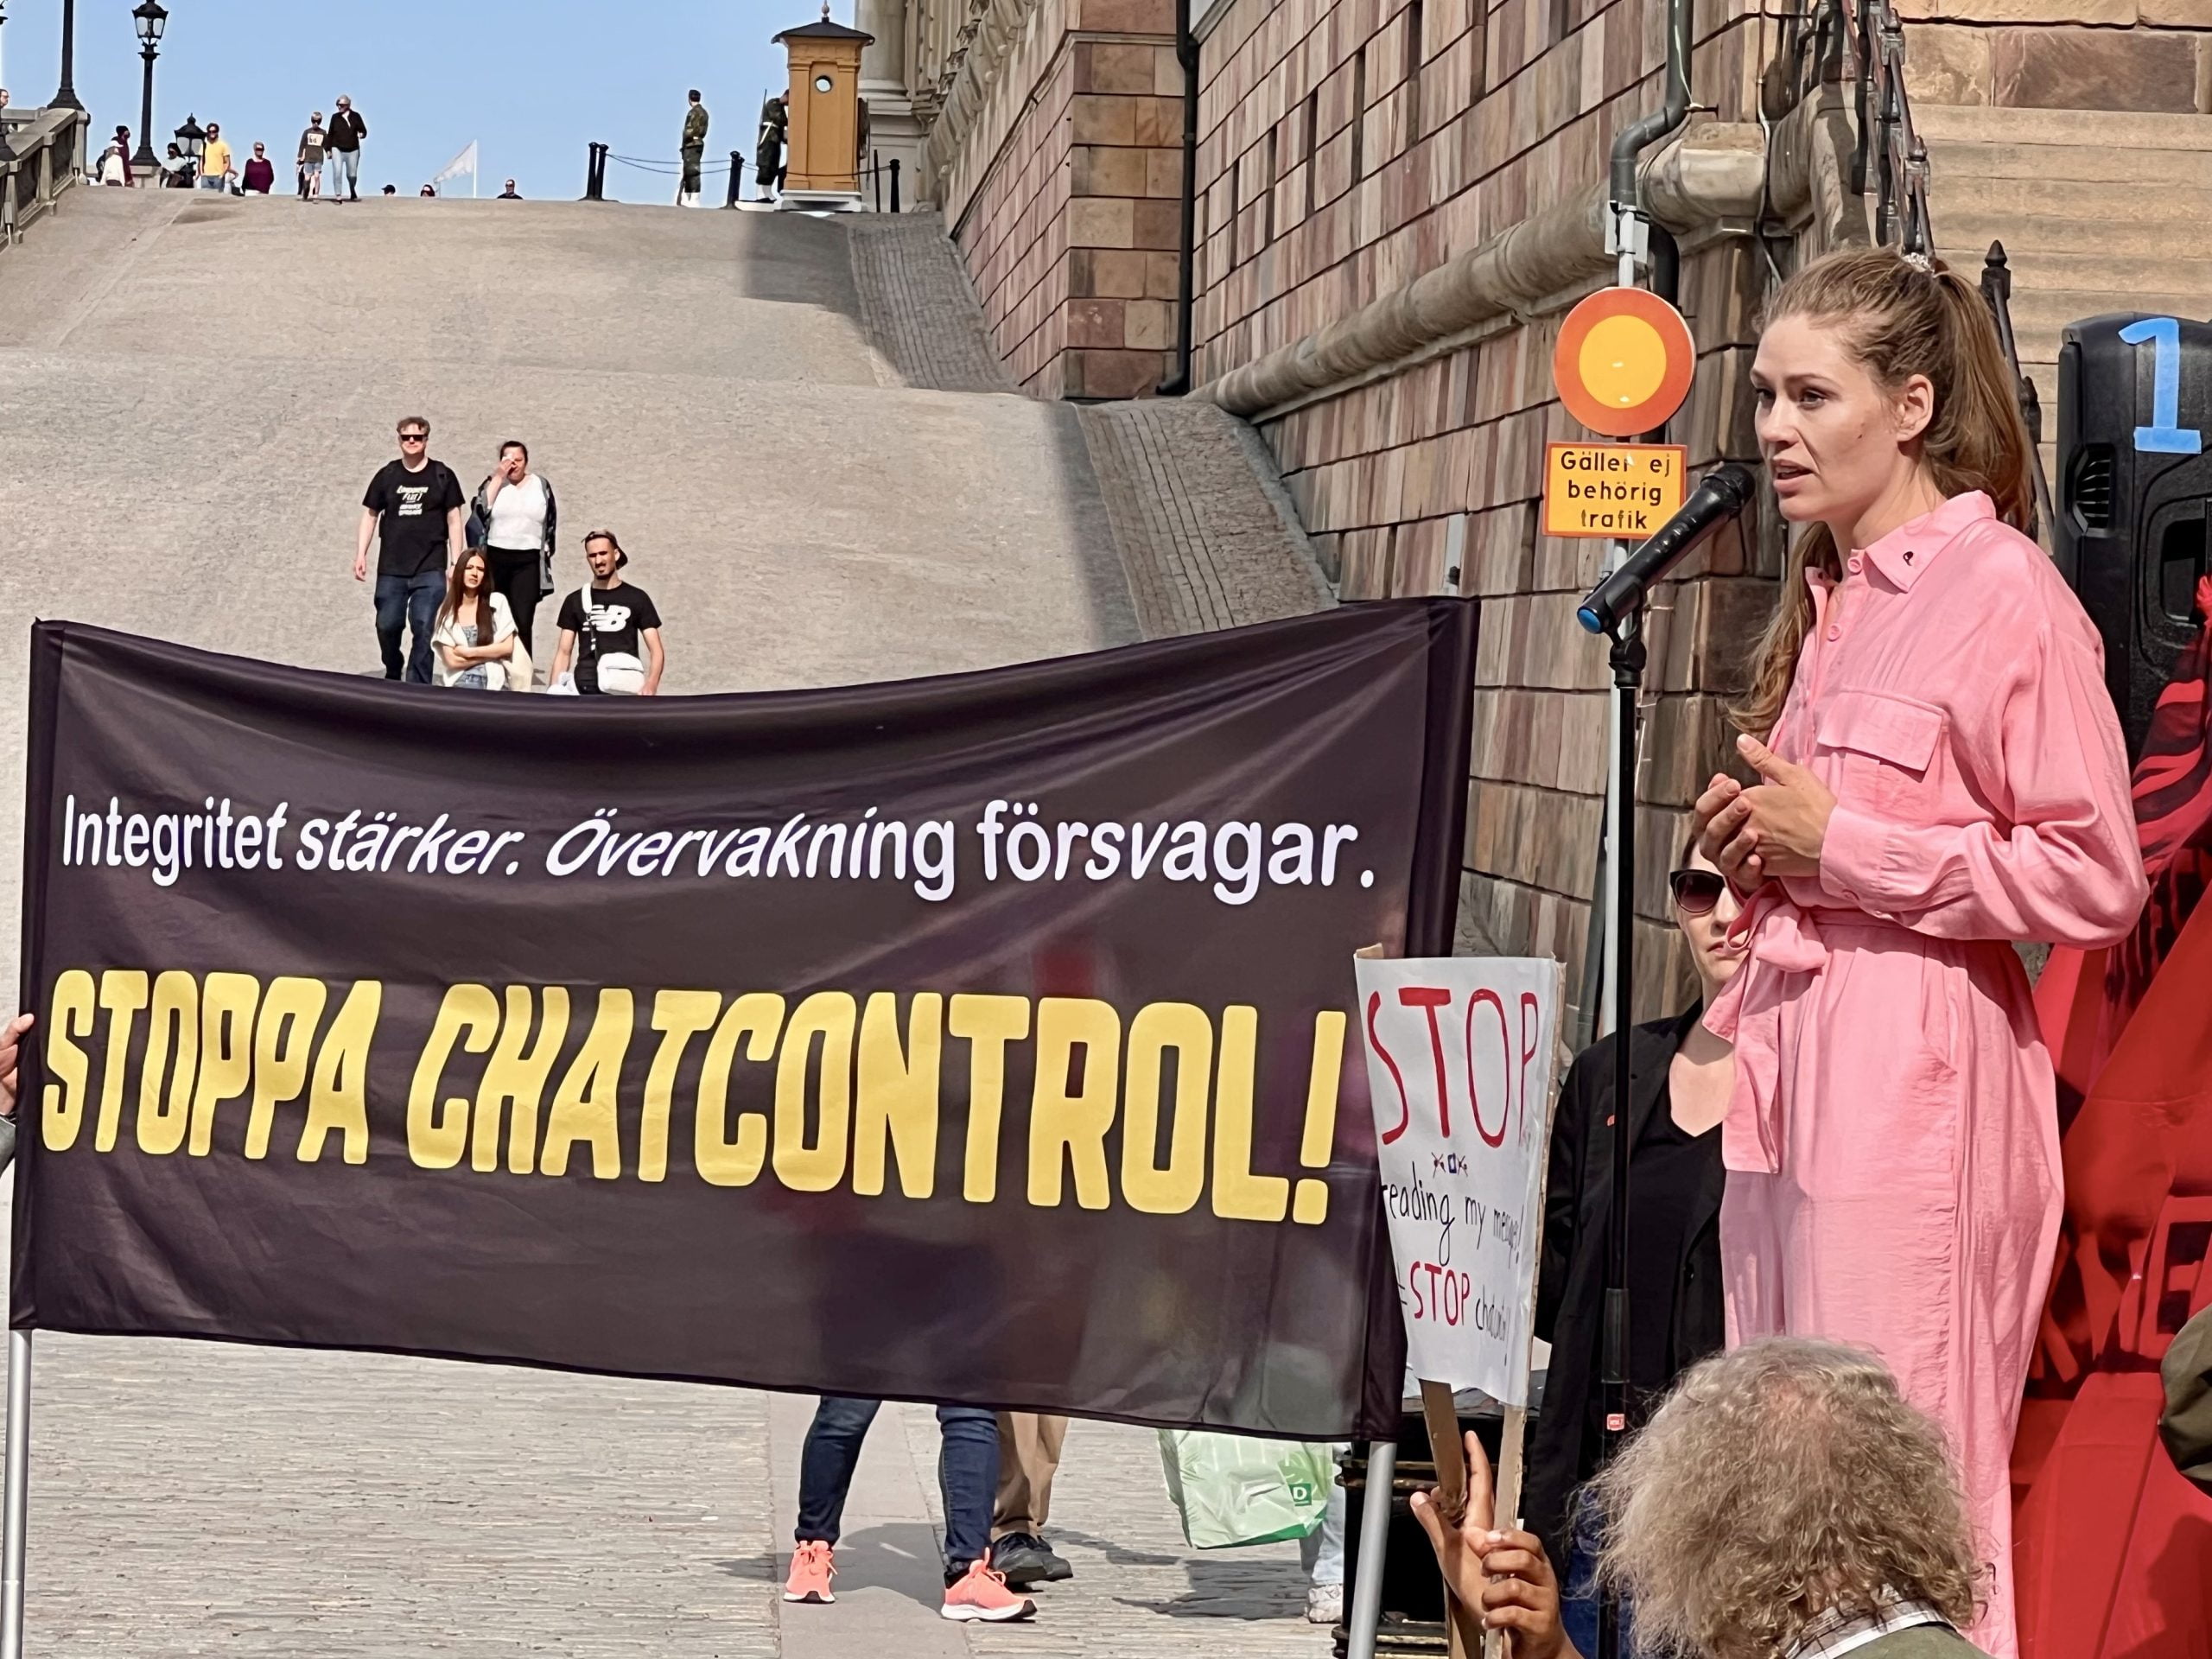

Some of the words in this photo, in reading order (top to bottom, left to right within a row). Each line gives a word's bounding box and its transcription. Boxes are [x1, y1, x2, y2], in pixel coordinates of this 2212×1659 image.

[2119, 317, 2202, 454] 1
[1560, 450, 1635, 472] Gäller
[1649, 453, 1670, 477] ej
[1568, 479, 1662, 507] behörig
[1581, 508, 1648, 529] trafik
[63, 794, 288, 886] Integritet
[296, 808, 524, 874] stärker.
[545, 806, 955, 901] Övervakning
[976, 799, 1376, 906] försvagar.
[42, 969, 382, 1165] STOPPA
[407, 983, 1346, 1224] CHATCONTROL!
[1366, 987, 1538, 1149] STOP
[1465, 1196, 1486, 1250] my
[1410, 1261, 1471, 1326] STOP
